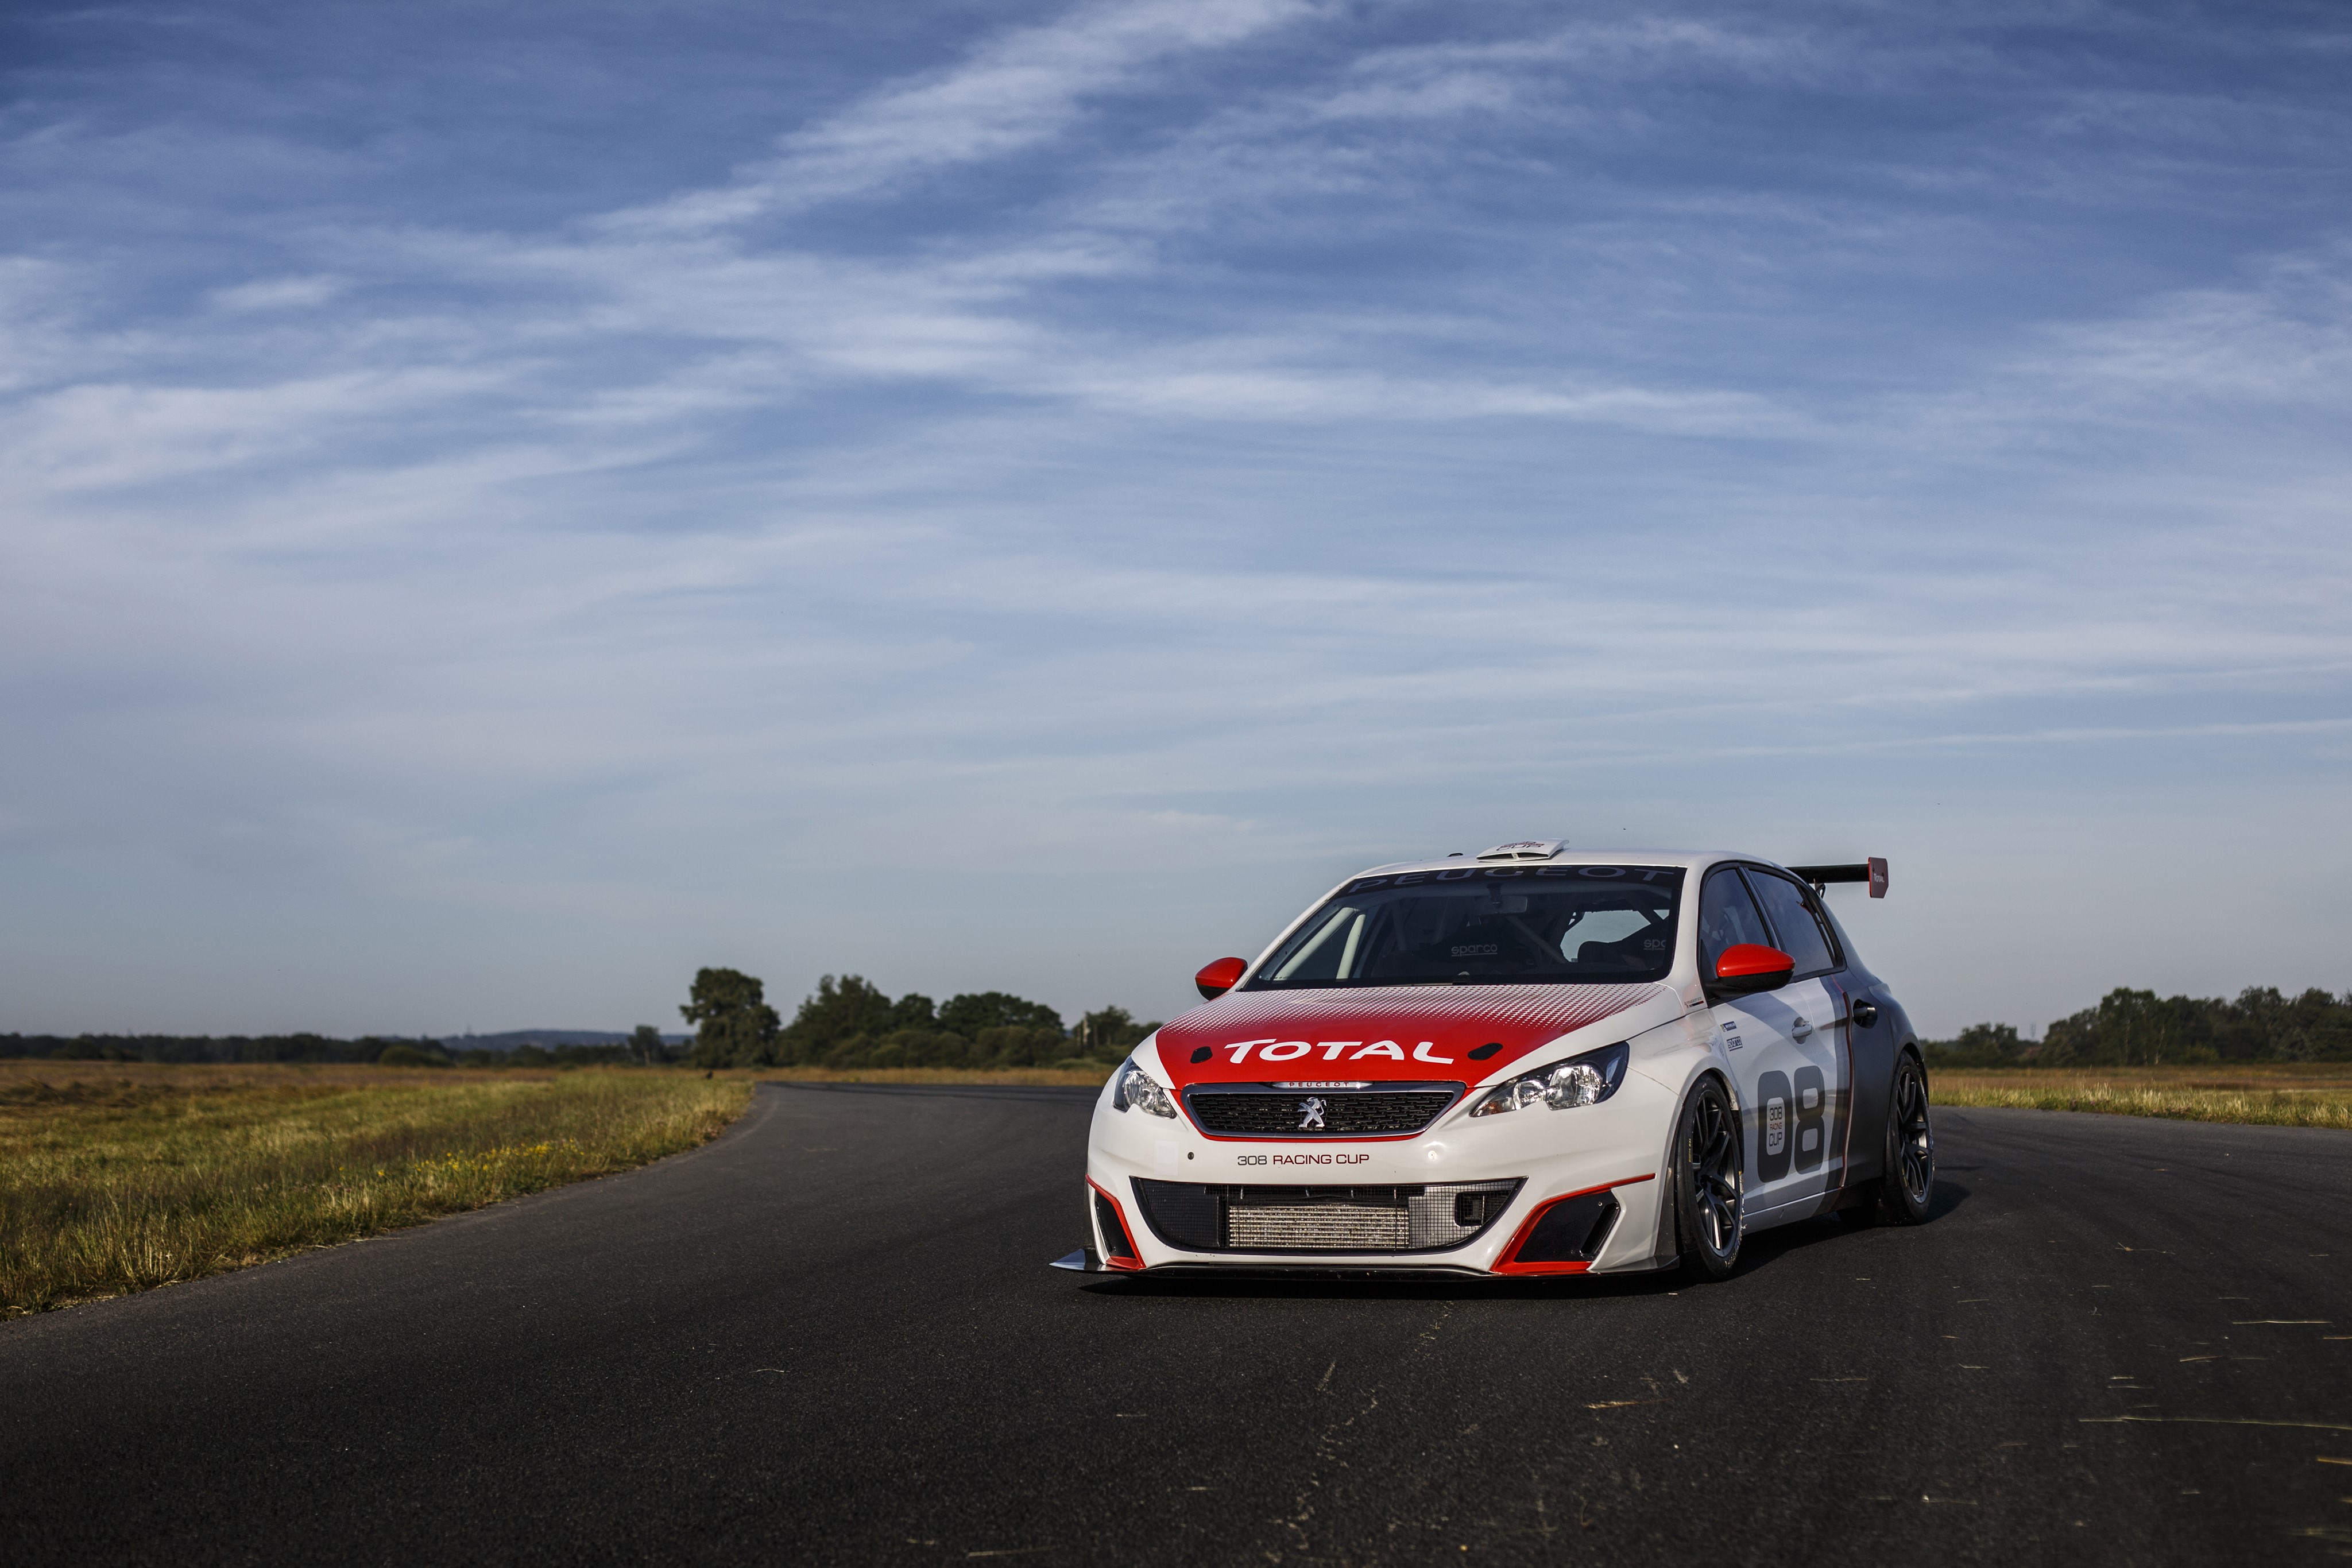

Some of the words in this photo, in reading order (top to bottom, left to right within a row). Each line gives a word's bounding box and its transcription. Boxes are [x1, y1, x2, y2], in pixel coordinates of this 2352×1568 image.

[1347, 865, 1674, 893] PEUGEOT
[1874, 873, 1884, 882] TOTAL
[1451, 944, 1498, 957] sparco
[1643, 939, 1667, 951] spa
[1224, 1039, 1454, 1064] TOTAL
[1769, 1106, 1782, 1121] 308
[1757, 1065, 1825, 1183] 08
[1770, 1122, 1782, 1130] RACING
[1769, 1132, 1782, 1147] CUP
[1237, 1156, 1267, 1166] 308
[1273, 1155, 1332, 1165] RACING
[1336, 1154, 1370, 1164] CUP
